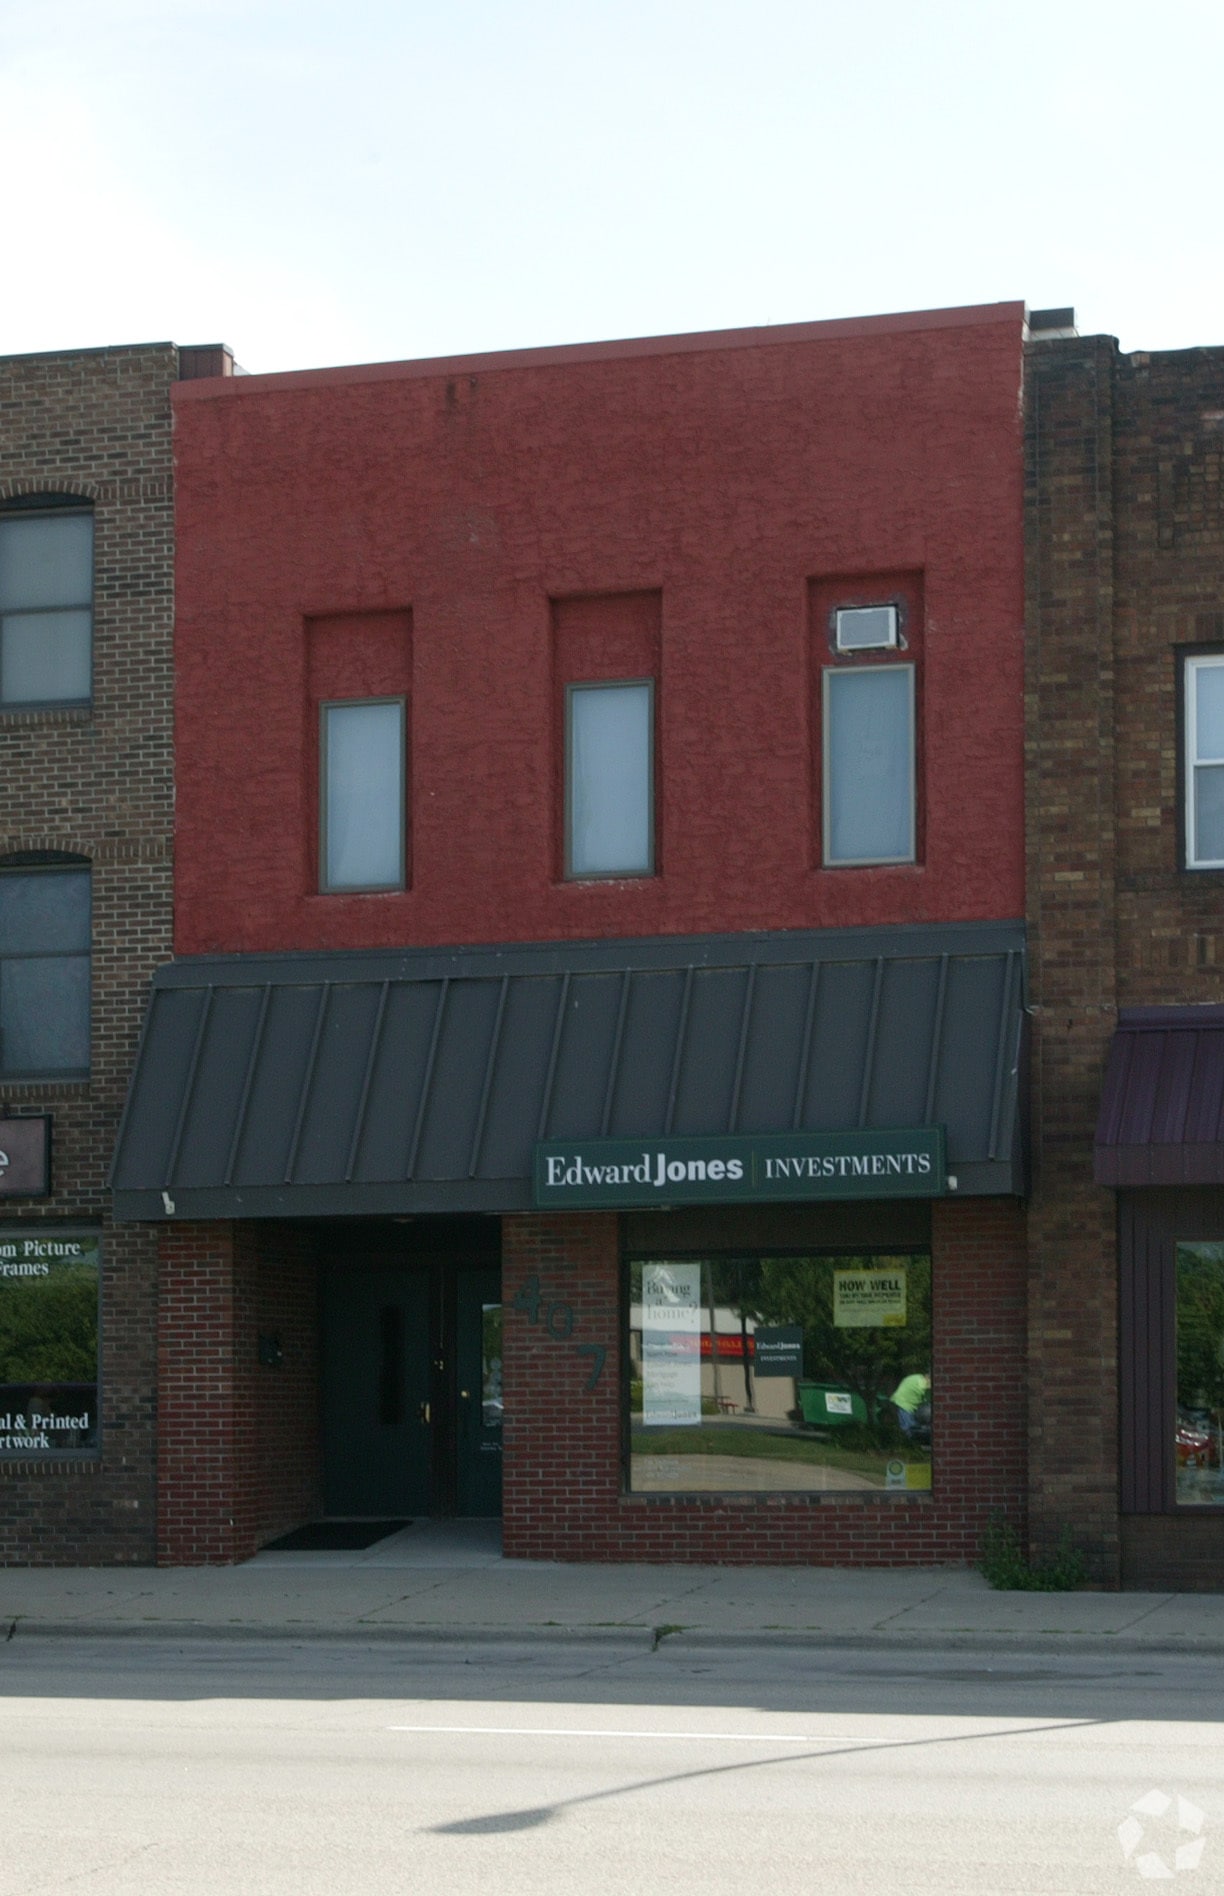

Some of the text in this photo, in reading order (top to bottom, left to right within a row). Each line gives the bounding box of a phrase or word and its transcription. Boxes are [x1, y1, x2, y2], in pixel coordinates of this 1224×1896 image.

[765, 1153, 931, 1179] INVESTMENTS
[24, 1240, 81, 1256] Picture
[839, 1279, 902, 1291] HOW WELL
[14, 1413, 26, 1430] &
[32, 1412, 89, 1430] Printed
